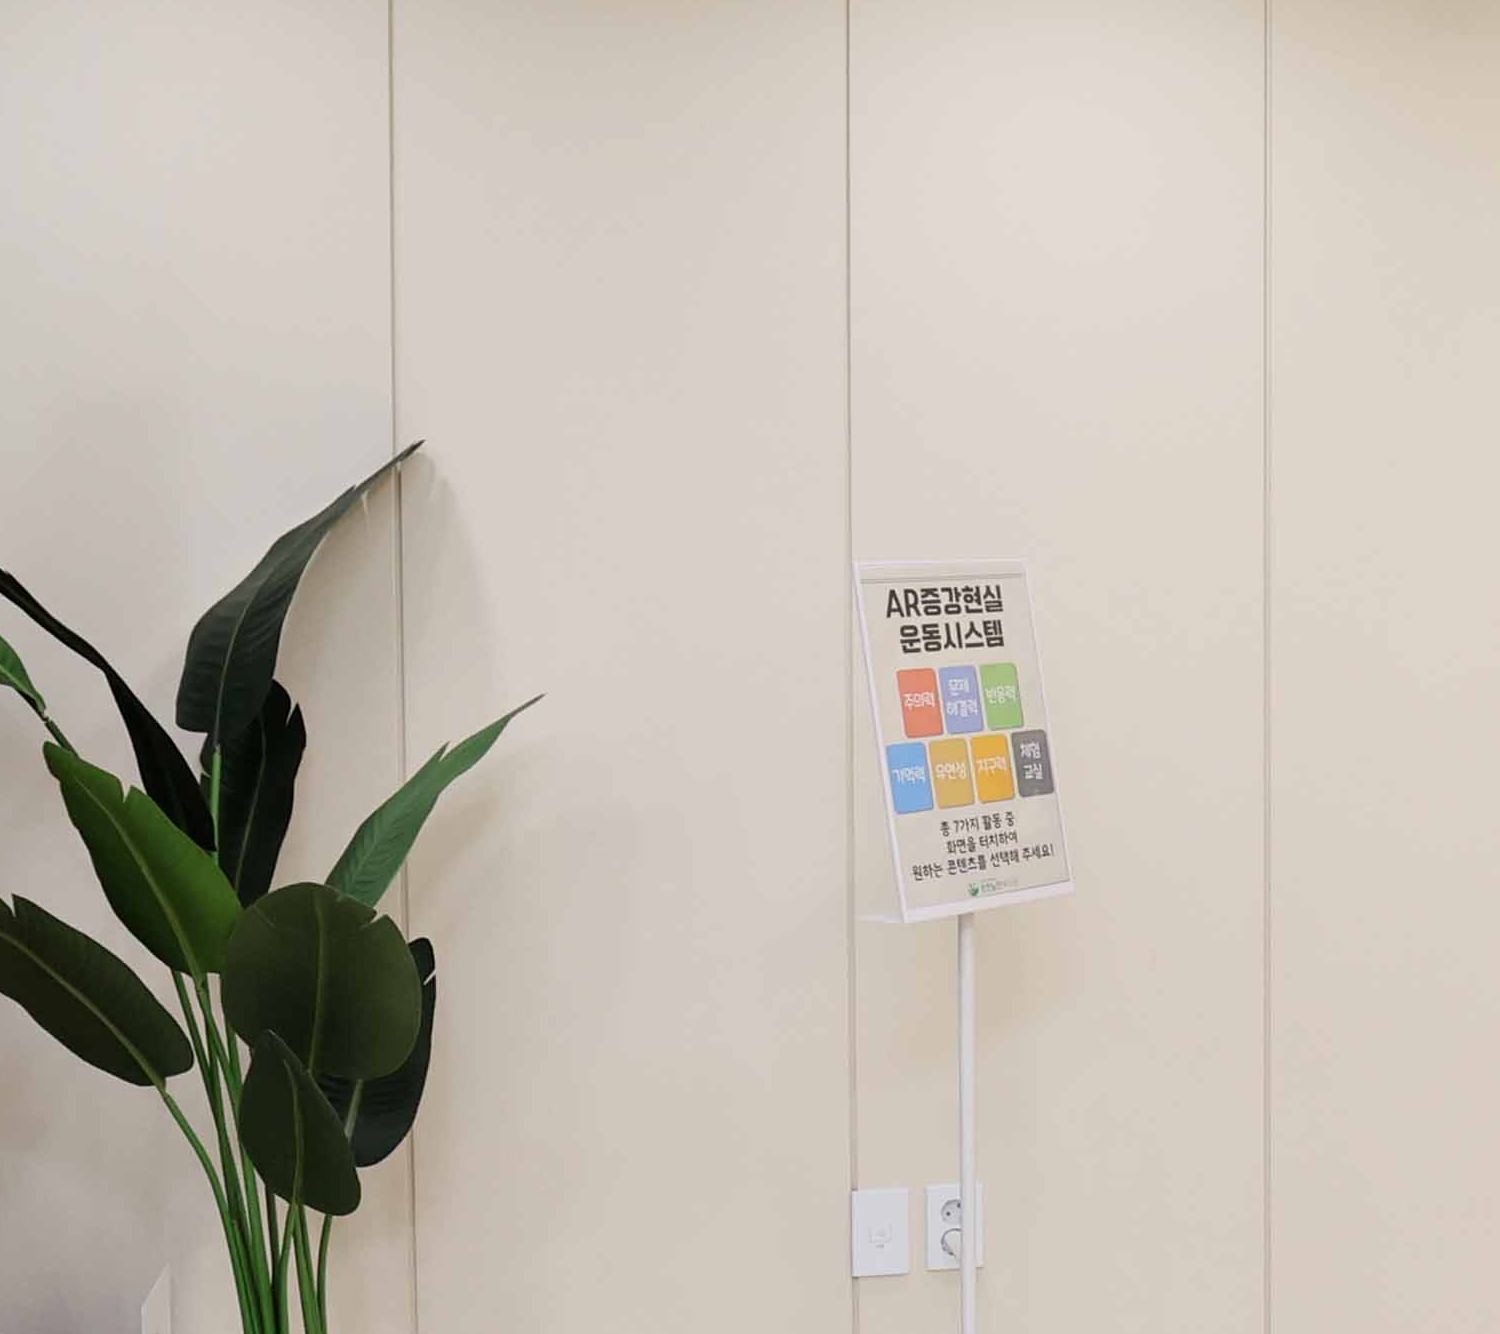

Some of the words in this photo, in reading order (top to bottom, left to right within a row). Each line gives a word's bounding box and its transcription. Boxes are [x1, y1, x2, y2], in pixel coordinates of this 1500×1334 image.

[886, 585, 1003, 618] AR증강현실
[900, 619, 1004, 654] 운동시스템
[954, 818, 980, 833] 7가지
[982, 813, 1002, 831] 활동
[1005, 811, 1015, 827] 중
[946, 837, 977, 854] 화면을
[979, 830, 1018, 849] 터치하여
[912, 863, 943, 882] 원하는
[990, 848, 1019, 868] 선택해
[1022, 843, 1055, 861] 주세요!
